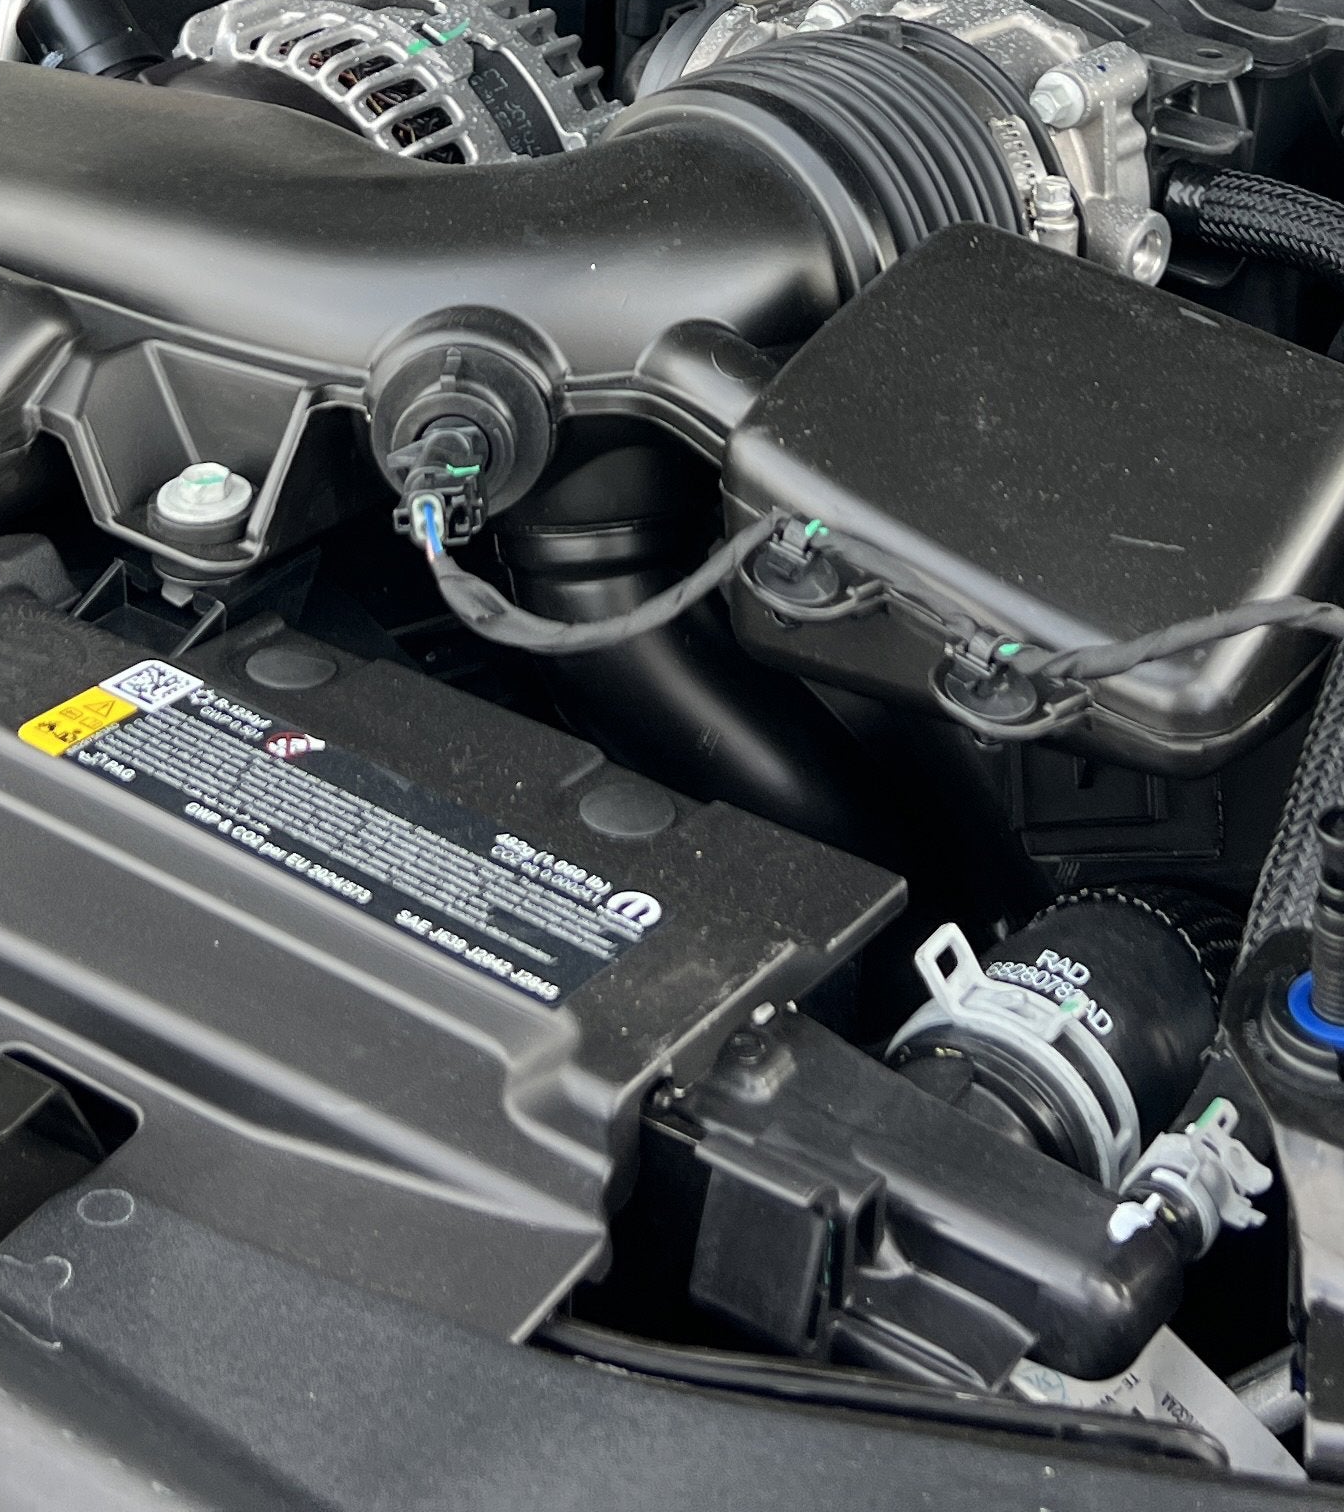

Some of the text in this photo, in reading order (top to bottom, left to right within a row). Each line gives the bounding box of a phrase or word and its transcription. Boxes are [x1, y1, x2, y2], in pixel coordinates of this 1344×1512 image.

[200, 705, 233, 726] GWP
[103, 759, 136, 782] PAG
[185, 801, 222, 825] GWP
[231, 825, 265, 849] CO2
[257, 841, 289, 862] per
[284, 852, 312, 873] EU
[306, 864, 373, 905] 2024/573
[491, 845, 523, 869] CO2
[585, 874, 612, 896] lb)
[394, 909, 433, 936] SAE
[1035, 948, 1092, 987] RAD
[985, 961, 1115, 1037] 6828078AD
